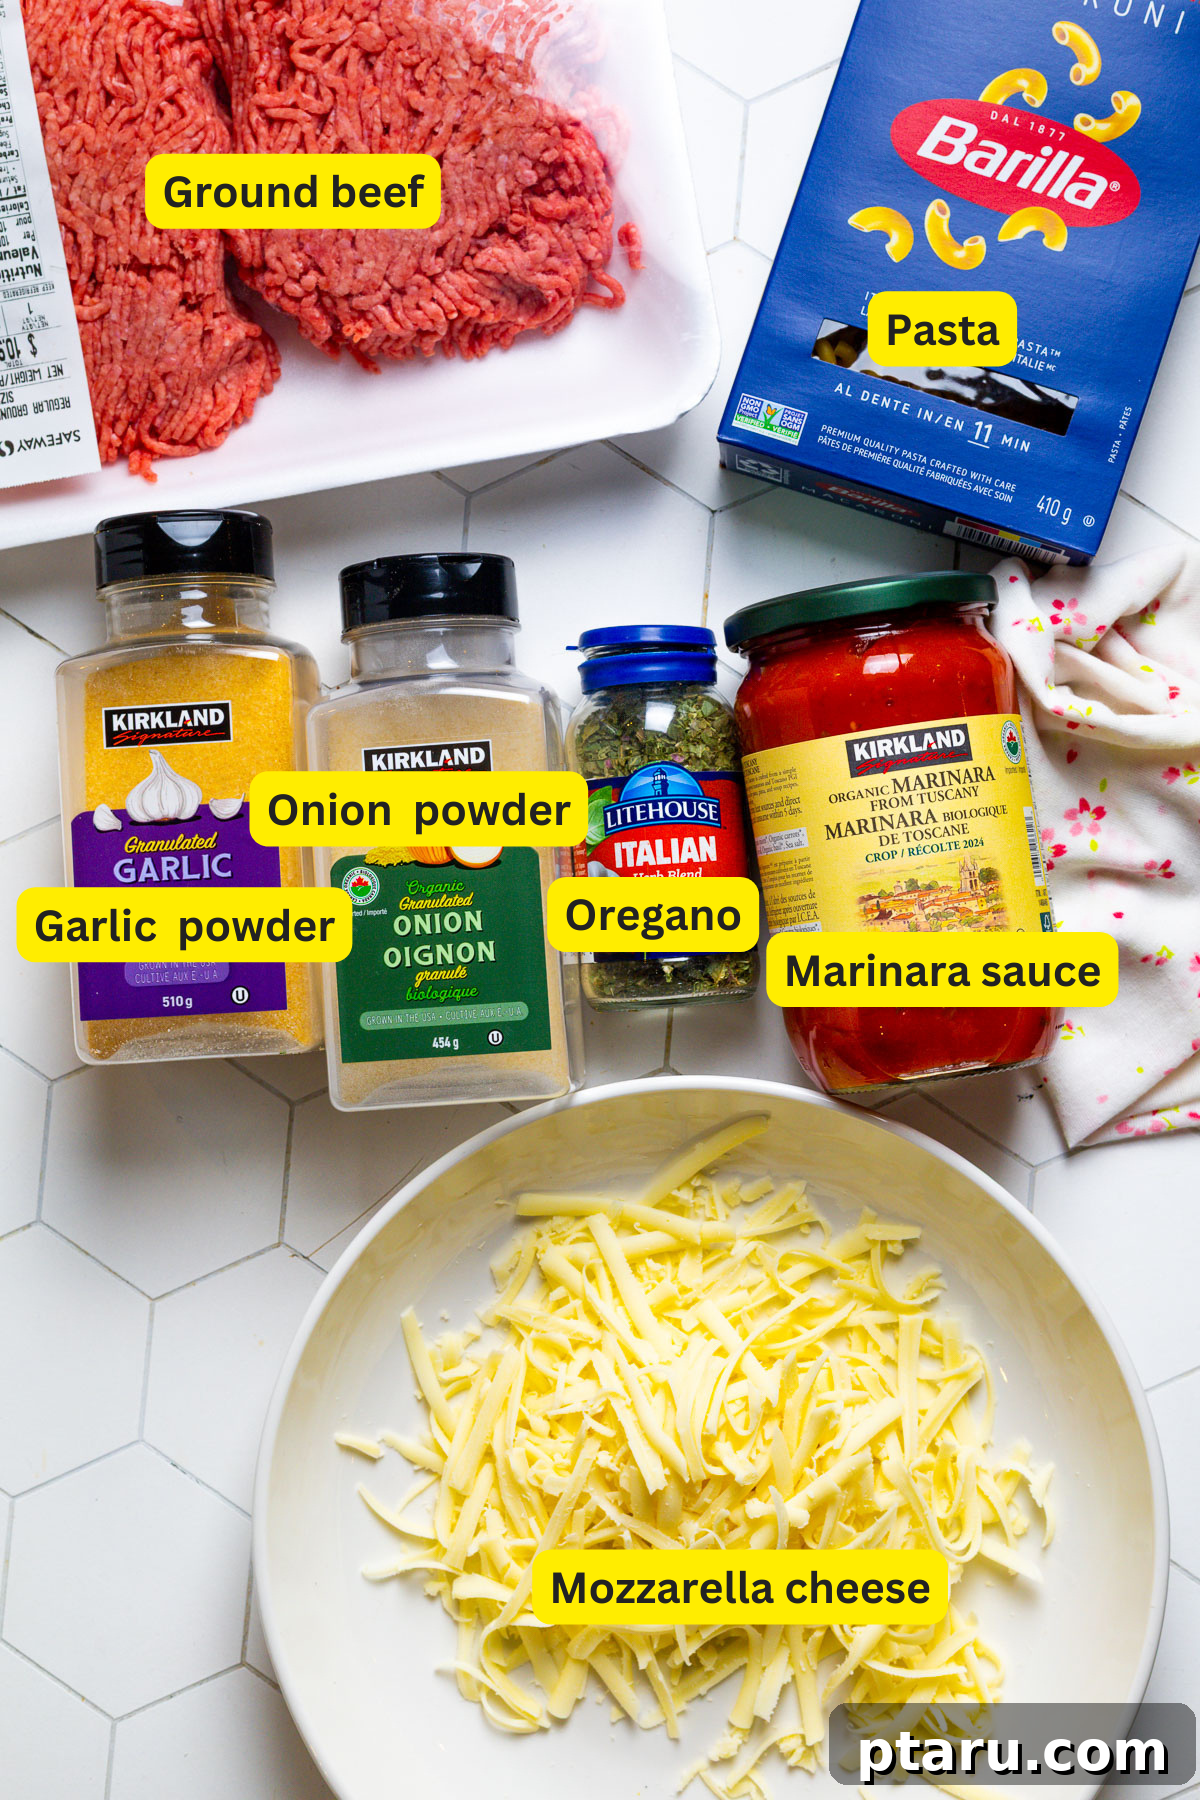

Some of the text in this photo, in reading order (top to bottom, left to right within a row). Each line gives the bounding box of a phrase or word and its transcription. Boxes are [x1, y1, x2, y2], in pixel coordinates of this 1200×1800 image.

[990, 111, 1066, 142] DAL 1877
[16, 217, 32, 226] pour
[23, 230, 36, 242] Per
[27, 333, 38, 358] $
[47, 364, 64, 379] NET
[33, 396, 71, 414] REGULAR
[740, 402, 760, 413] GMO
[742, 396, 762, 407] NON
[834, 383, 1031, 453] AL DENTE IN/EN 11 MIN
[17, 429, 81, 453] SAFEWAY
[1107, 440, 1122, 464] PASTA
[817, 434, 1014, 503] PÂTES DE PREMIÈRE QUALITÉ FABRIQUÉES AVEC SOIN
[820, 424, 1017, 493] PREMIUM QUALITY PASTA CRAFTED WITH CARE
[1036, 494, 1072, 526] 410 g
[112, 708, 225, 732] KIRKLAND
[112, 728, 226, 747] Signature
[852, 729, 966, 762] KIRKLAND
[371, 747, 486, 771] KIRKLAND
[855, 751, 969, 776] Signature
[828, 785, 890, 804] ORGANIC
[891, 765, 996, 795] MARINARA
[870, 785, 981, 812] FROM TUSCANY
[606, 800, 719, 829] LITEHOUSE
[823, 804, 1008, 841] MARINARA BIOLOGIQUE
[124, 831, 219, 854] Granulated
[878, 823, 970, 848] DE TOSCANE
[614, 835, 718, 869] ITALIAN
[864, 849, 898, 864] CROP
[907, 841, 961, 858] RÉCOLTE
[962, 837, 985, 850] 2024
[113, 853, 232, 884] GARLIC
[667, 867, 703, 877] Blend
[406, 880, 465, 898] Organic
[398, 891, 474, 912] Granulated
[393, 910, 483, 937] ONION
[383, 940, 496, 968] OIGNON
[173, 972, 189, 982] AUX
[414, 964, 468, 988] granulé
[405, 985, 479, 1003] biologique
[366, 1014, 393, 1026] GROWN
[395, 1013, 403, 1024] IN
[405, 1012, 419, 1023] THE
[422, 1012, 436, 1023] USA
[479, 1008, 495, 1018] AUX
[432, 1036, 459, 1050] 454 g
